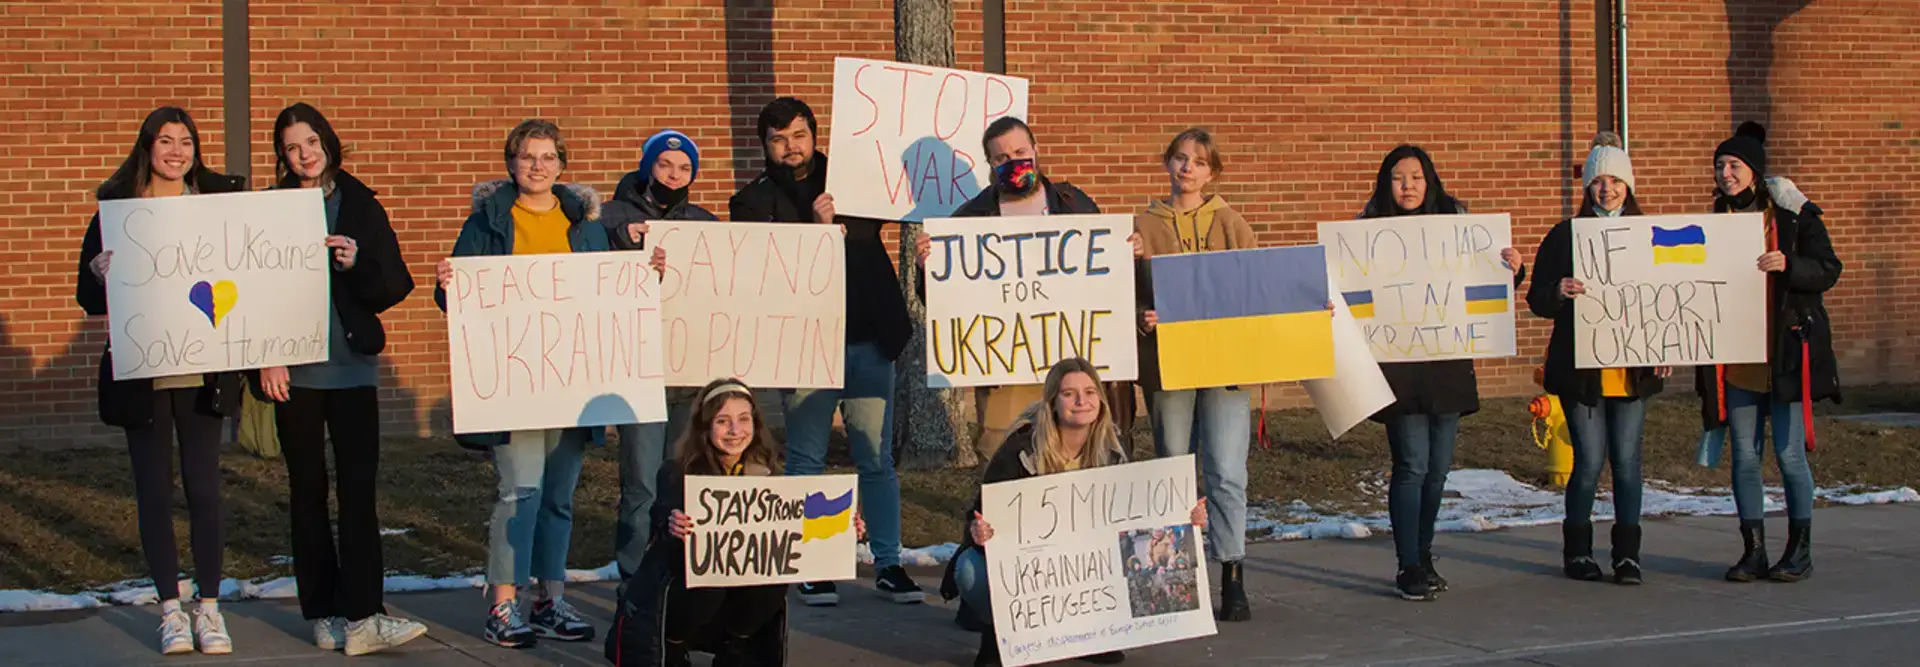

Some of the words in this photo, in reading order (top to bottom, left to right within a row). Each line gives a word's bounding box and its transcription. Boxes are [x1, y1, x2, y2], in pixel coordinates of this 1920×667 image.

[852, 64, 1013, 140] STOP
[876, 140, 975, 205] WAR
[122, 207, 214, 287] Save
[659, 227, 748, 302] SAY
[759, 231, 836, 297] NO
[930, 229, 1111, 281] JUSTICE
[1337, 228, 1407, 277] NO
[1422, 224, 1497, 273] WAR
[1577, 227, 1634, 285] WE
[455, 261, 572, 314] PEACE
[597, 261, 649, 299] FOR
[1001, 280, 1049, 303] FOR
[1383, 281, 1452, 325] IN
[1581, 280, 1727, 329] SUPPORT
[120, 313, 206, 375] Save
[462, 308, 664, 400] UKRAINE
[662, 316, 688, 373] O
[707, 312, 839, 384] PUTIN
[932, 310, 1112, 378] UKRAINE
[1592, 319, 1714, 366] UKRAIN
[697, 488, 757, 525] STAY
[1006, 485, 1059, 544] 1.5
[1071, 476, 1190, 532] MILLION
[690, 529, 803, 576] UKRAINE
[1000, 548, 1113, 598] UKRAINIAN
[1008, 586, 1117, 632] REFUGEES
